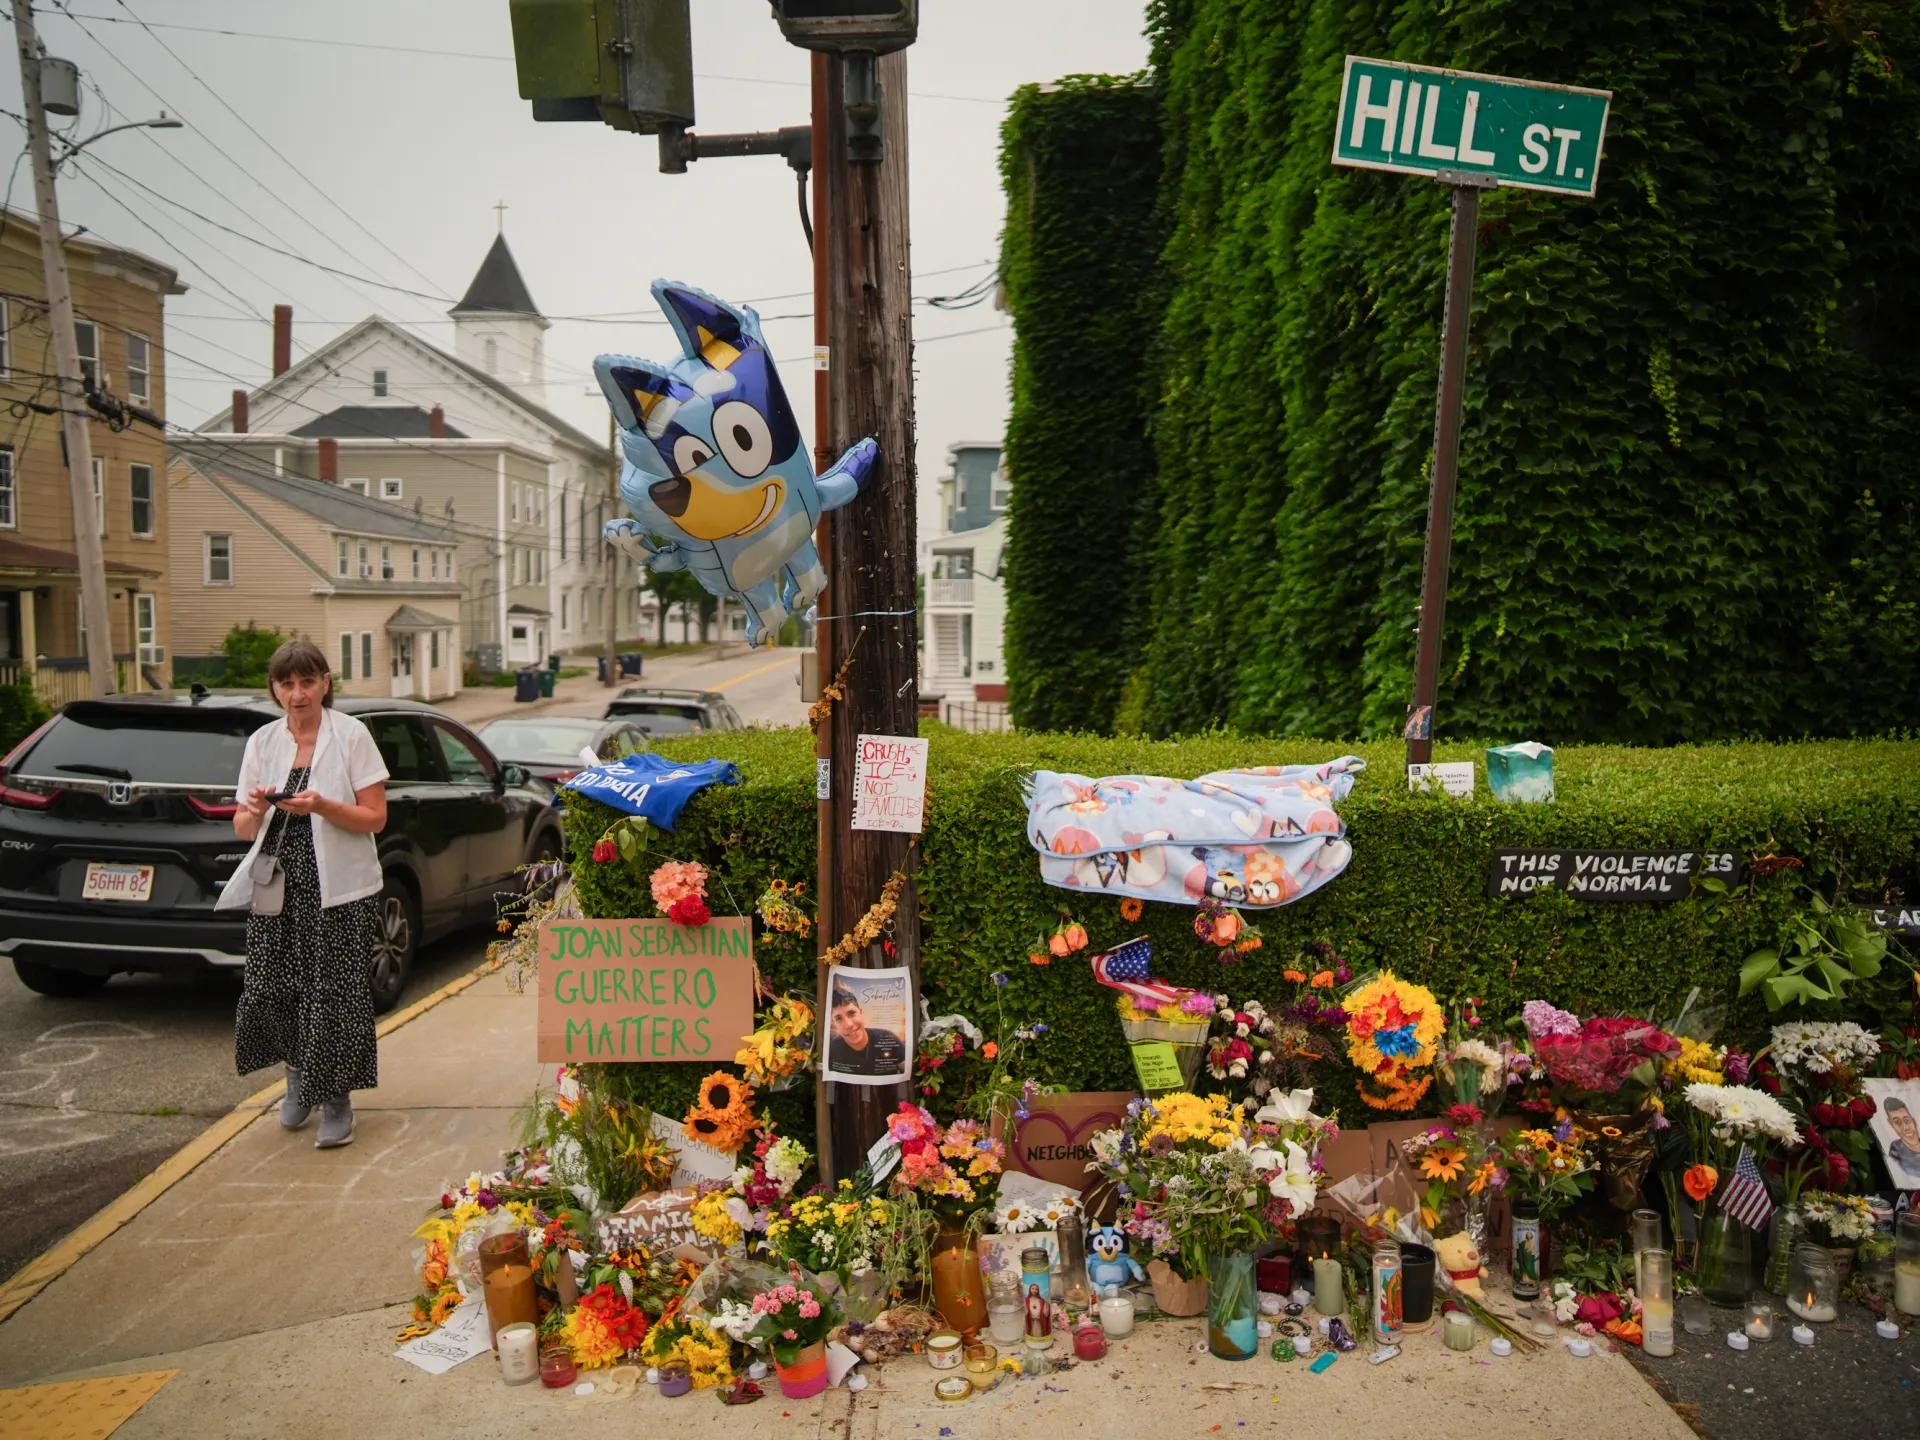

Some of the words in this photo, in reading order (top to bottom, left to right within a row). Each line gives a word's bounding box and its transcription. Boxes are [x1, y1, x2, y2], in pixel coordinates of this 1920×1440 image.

[1350, 75, 1495, 166] HILL
[1519, 123, 1585, 179] ST.
[863, 741, 907, 762] CRUSH
[864, 761, 908, 780] ICE
[865, 780, 894, 796] NOT
[1500, 854, 1561, 872] THIS
[1575, 853, 1693, 875] VIOLENCE
[1705, 853, 1733, 872] IS
[89, 873, 126, 890] 5GHH
[1500, 876, 1556, 893] NOT
[1567, 876, 1672, 893] NORMAL
[550, 926, 622, 961] JOAN
[629, 925, 749, 959] SEBASTIAN
[554, 967, 717, 1009] GUERRERO
[565, 1014, 712, 1057] MATTERS
